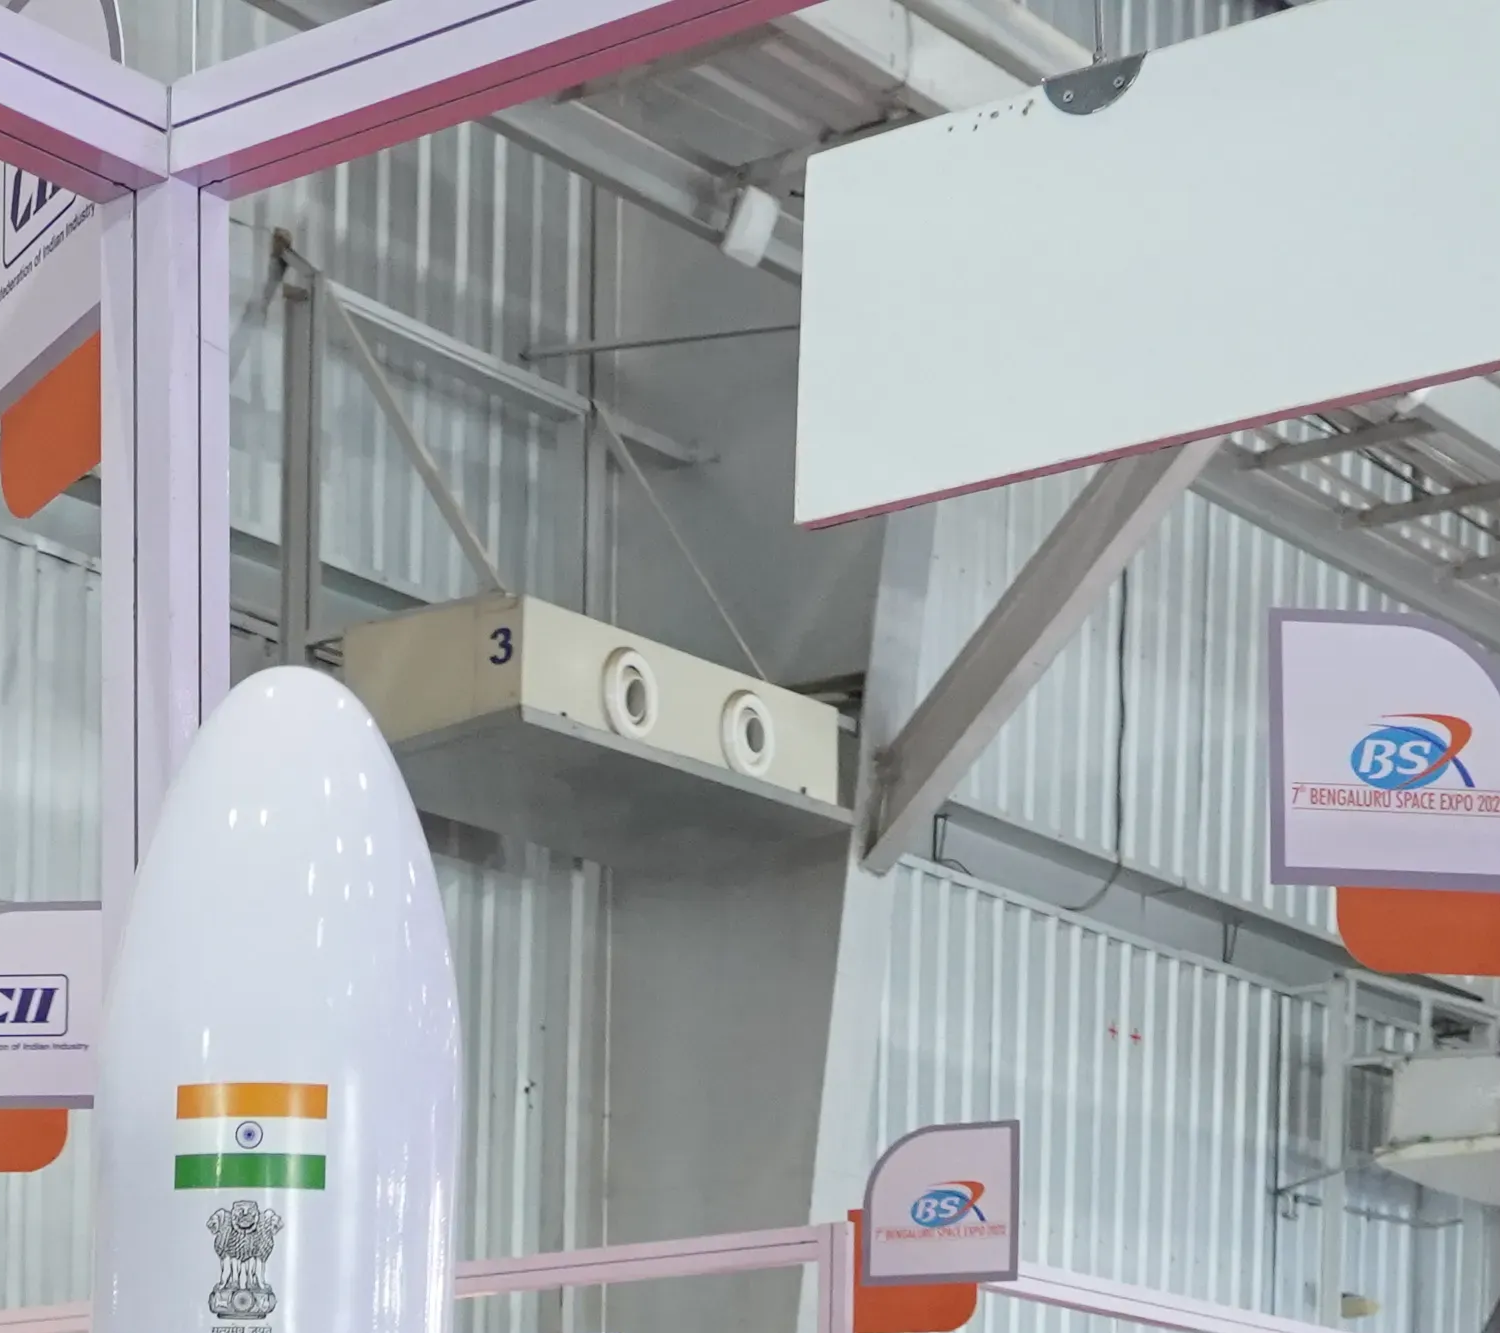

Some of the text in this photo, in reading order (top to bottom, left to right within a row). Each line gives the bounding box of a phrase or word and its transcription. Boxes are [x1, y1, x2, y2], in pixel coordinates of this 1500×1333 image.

[34, 248, 43, 267] of
[43, 229, 64, 260] Indian
[66, 203, 96, 238] Industry
[488, 626, 515, 665] 3
[1310, 787, 1392, 810] BENGALURU
[1395, 790, 1436, 811] SPACE
[1440, 791, 1474, 812] EXPO
[11, 1042, 21, 1051] of
[23, 1042, 50, 1051] Indian
[52, 1042, 90, 1053] Industry
